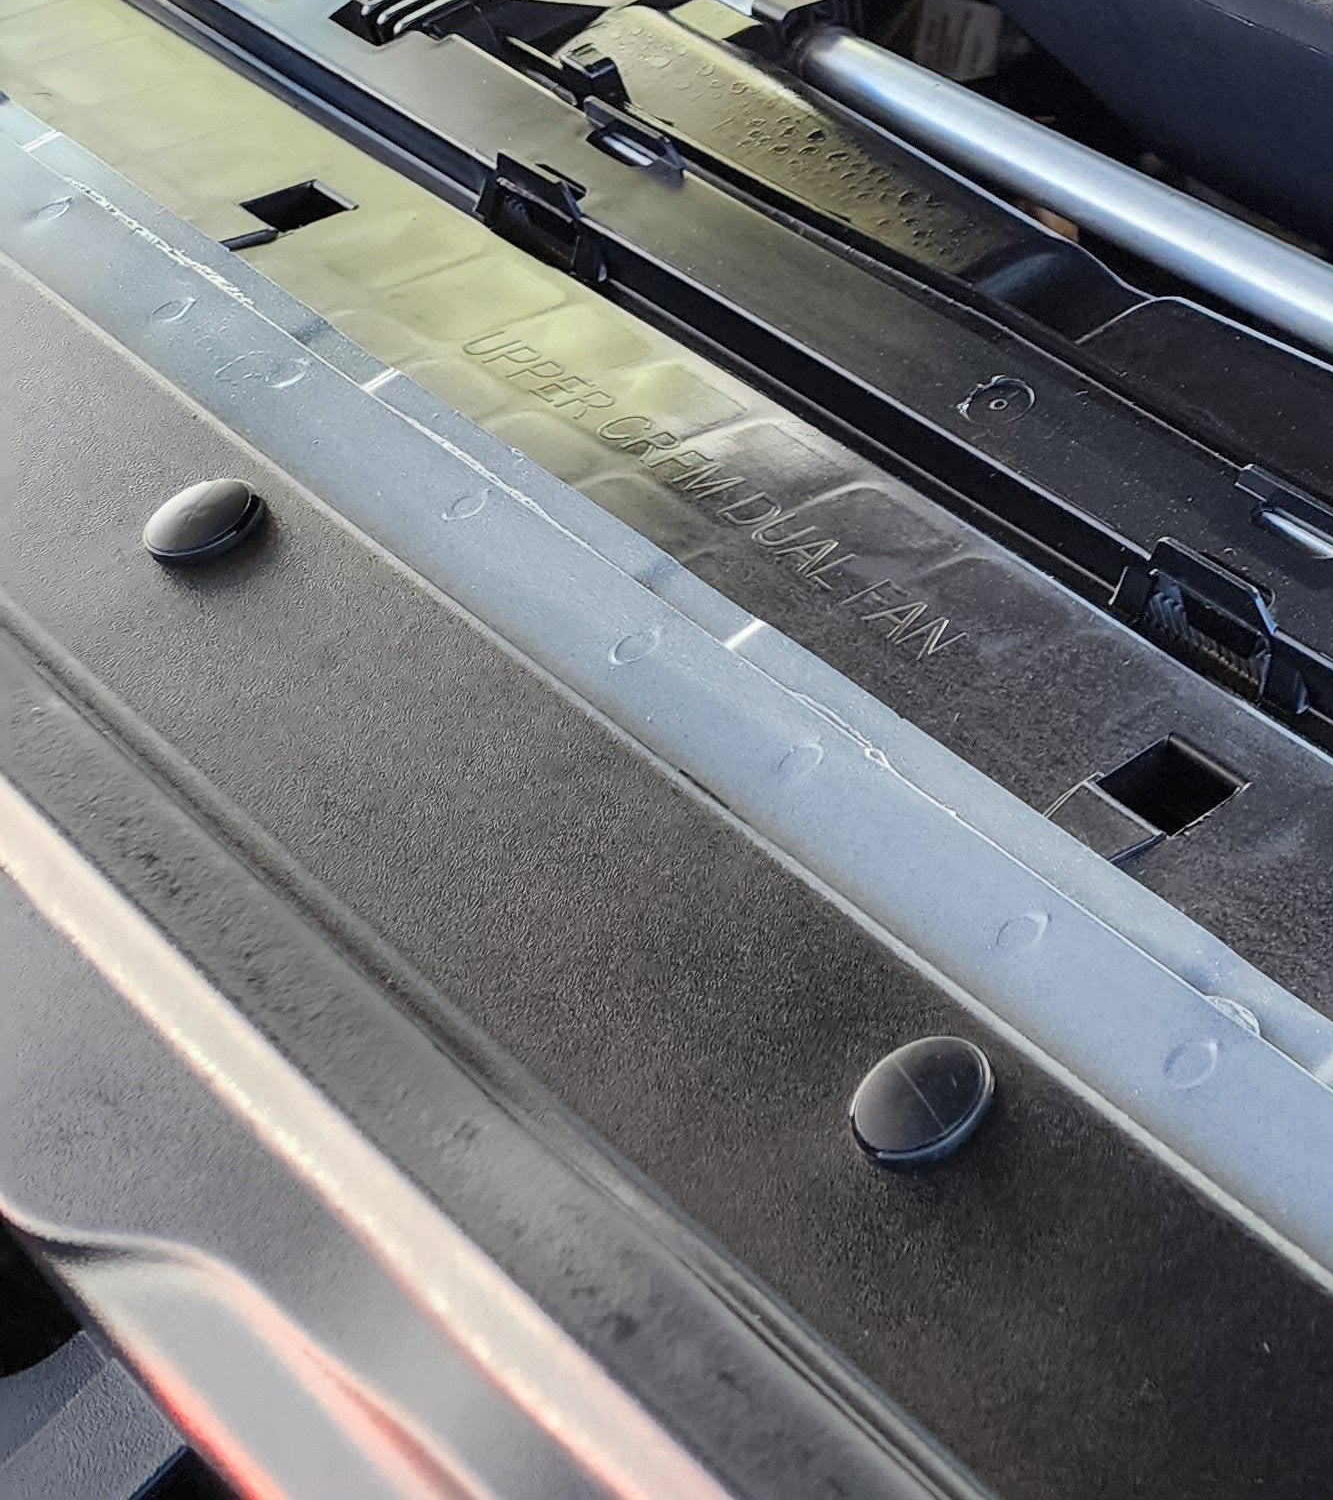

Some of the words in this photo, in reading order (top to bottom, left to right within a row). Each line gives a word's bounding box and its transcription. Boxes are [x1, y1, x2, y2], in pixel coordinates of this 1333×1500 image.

[461, 330, 615, 419] UPPER
[597, 415, 747, 500] CRFM
[717, 491, 858, 591] DUAL
[841, 578, 969, 661] FAN
